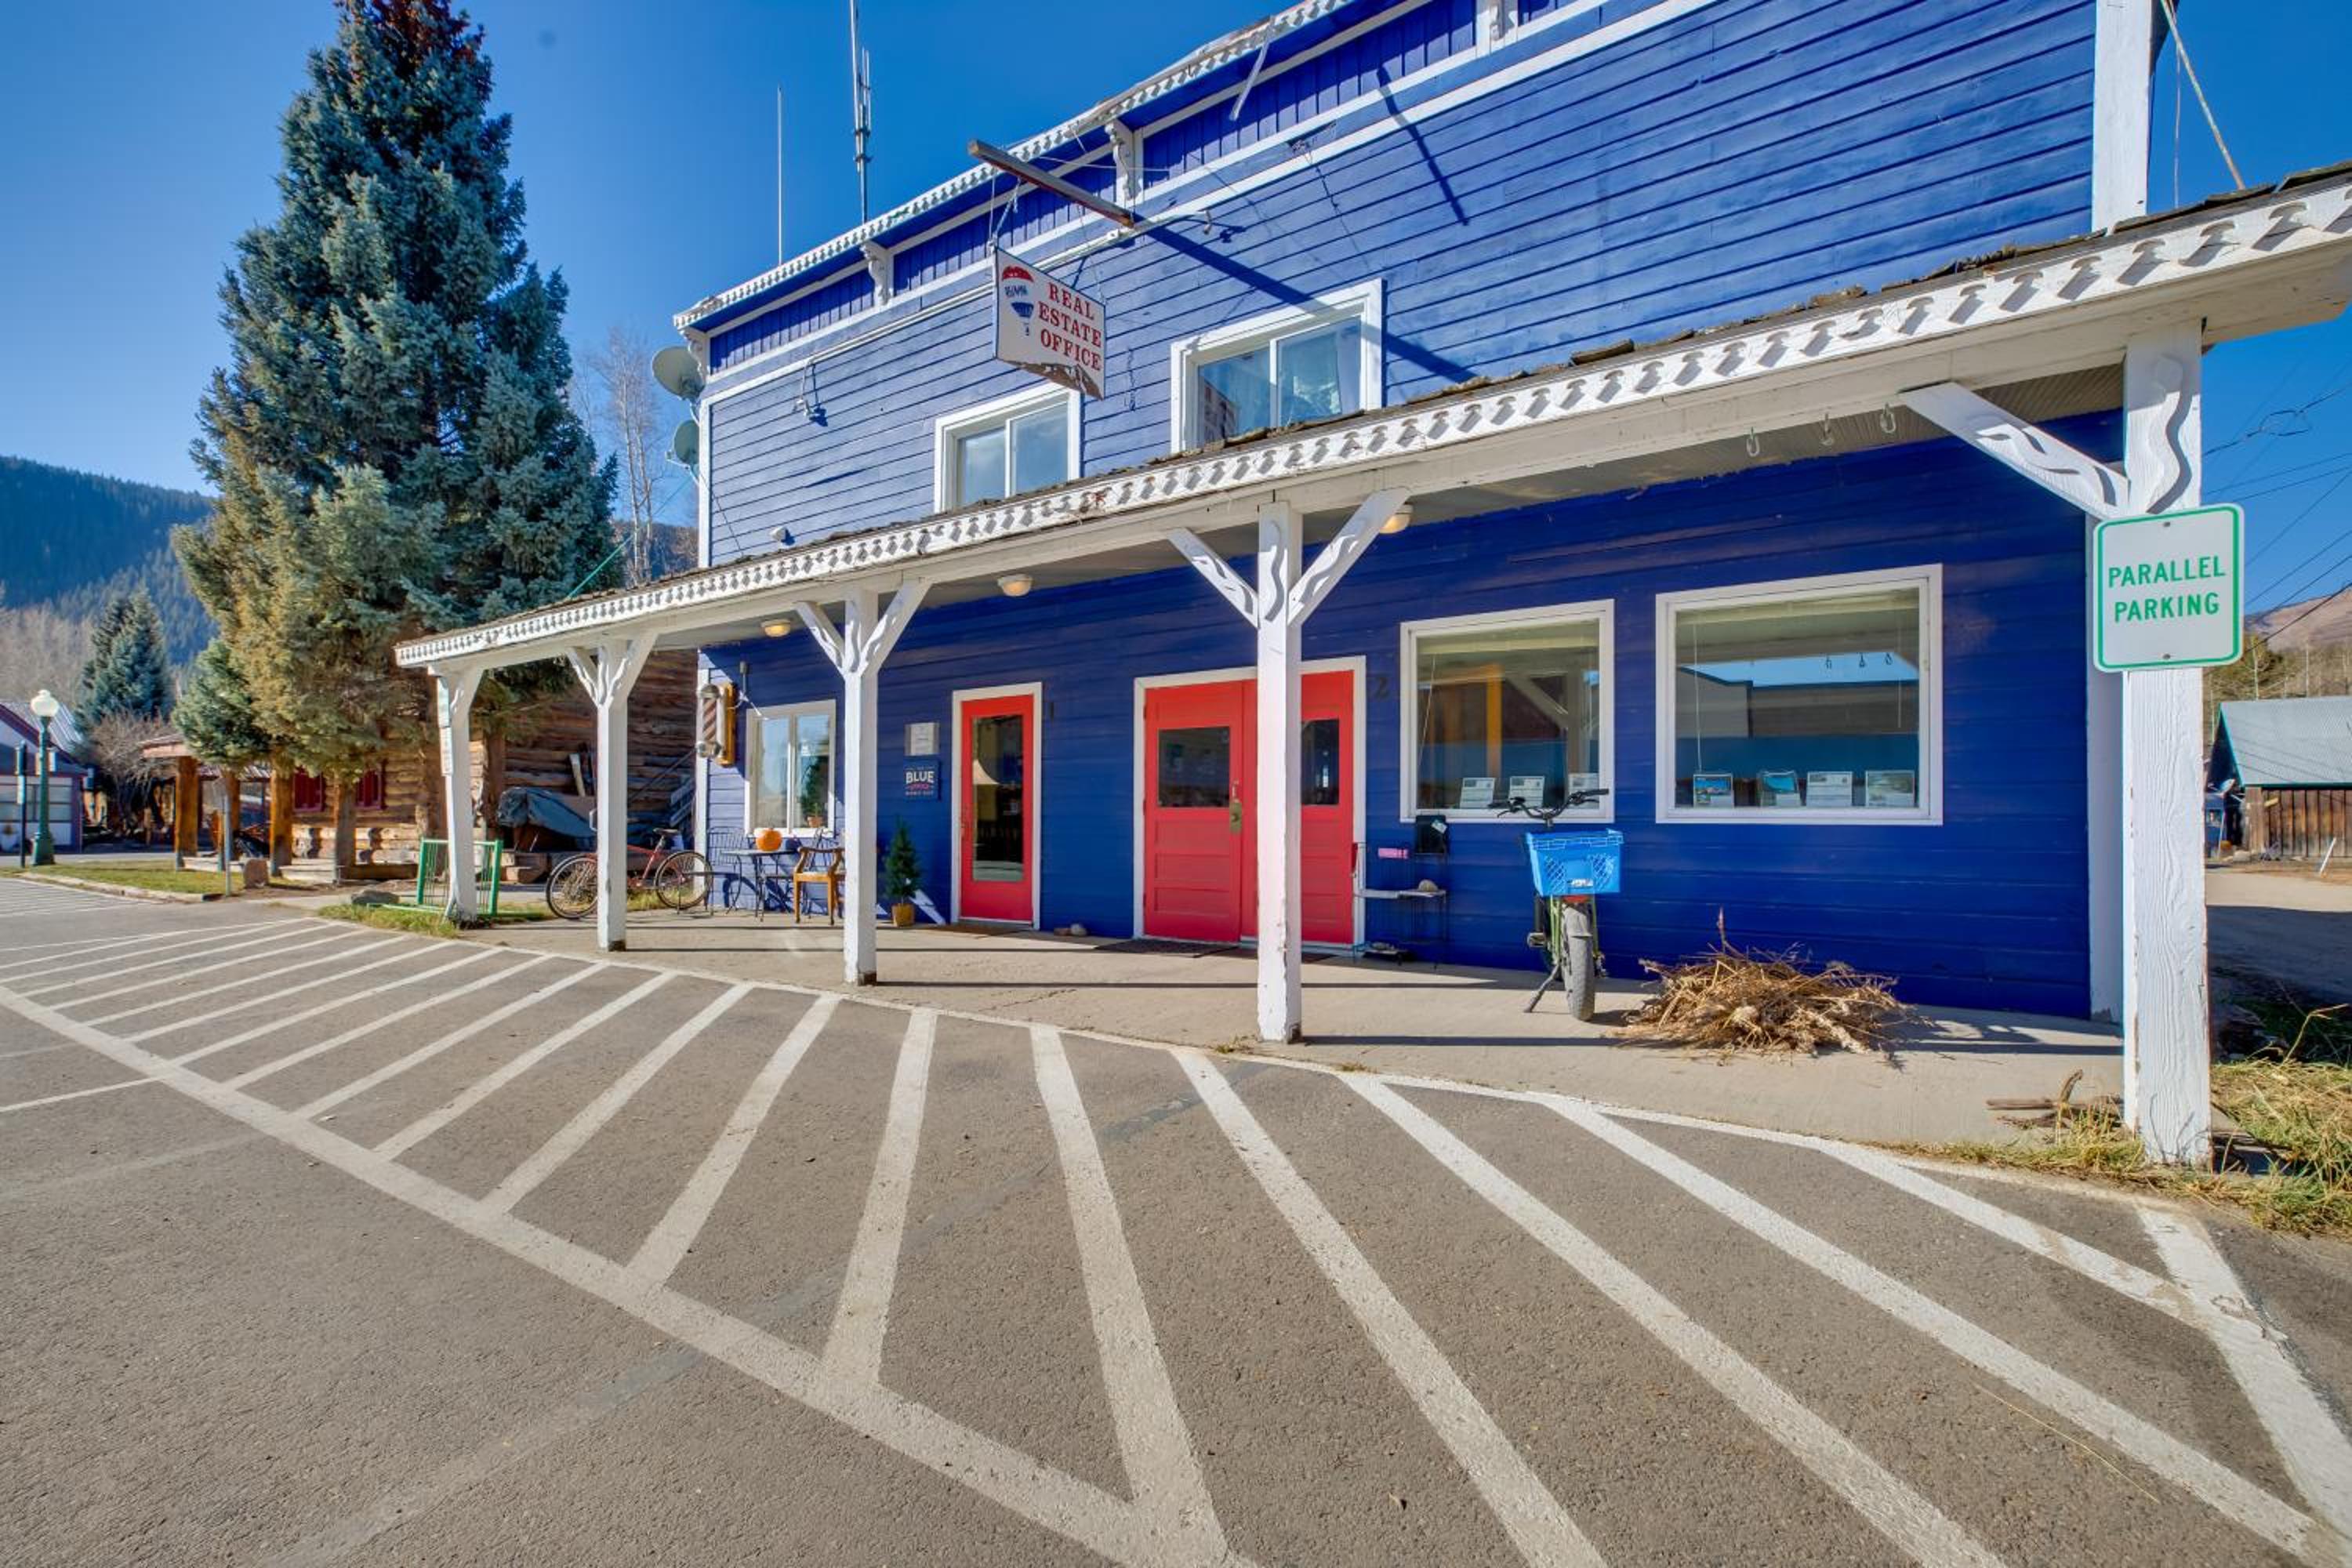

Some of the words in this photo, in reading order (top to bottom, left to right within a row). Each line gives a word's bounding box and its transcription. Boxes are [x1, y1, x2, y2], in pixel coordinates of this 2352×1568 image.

[1049, 283, 1094, 320] REAL
[1039, 303, 1102, 347] ESTATE
[1041, 329, 1101, 371] OFFICE
[2107, 555, 2226, 588] PARALLEL
[2114, 592, 2220, 622] PARKING
[906, 771, 935, 784] BLUE
